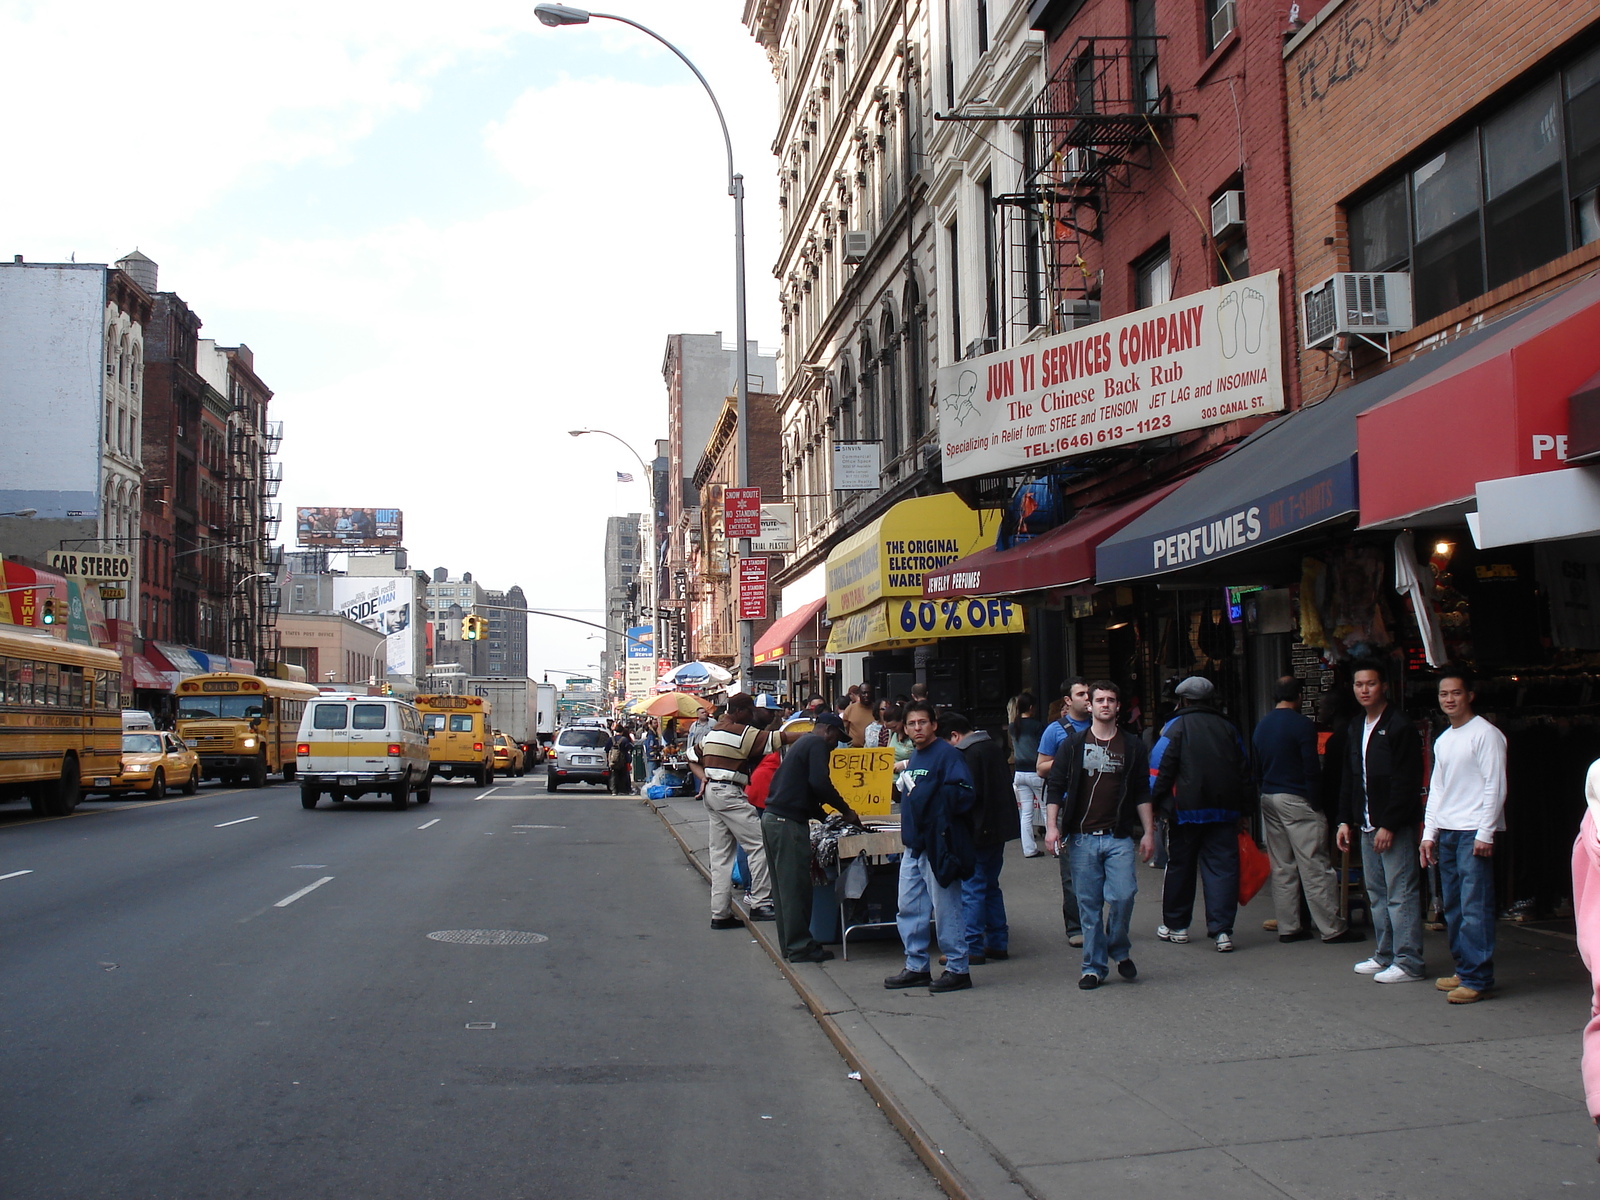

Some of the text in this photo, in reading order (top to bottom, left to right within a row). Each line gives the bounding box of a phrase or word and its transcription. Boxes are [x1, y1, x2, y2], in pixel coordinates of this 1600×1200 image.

[986, 305, 1204, 402] JUN YI SERVICES COMPANY
[1007, 361, 1183, 421] The Chinese Back Rub
[946, 367, 1268, 459] Specializing in Relief form: STREE and TENSION JET LAG and INSOMNIA
[1201, 396, 1265, 420] 303 CANAL ST.
[726, 490, 759, 499] SNOW ROUTE
[375, 509, 399, 523] HUFF
[726, 509, 759, 518] NO STANDING
[769, 541, 789, 550] PLASTIC
[886, 539, 959, 554] THE ORIGINAL
[1153, 506, 1261, 569] PERFUMES
[53, 554, 129, 578] CAR STEREO
[888, 573, 924, 587] WARE
[927, 570, 981, 594] JEWELRY PERFUMES
[102, 588, 121, 597] PIZZA
[340, 591, 396, 621] NSIDE MAN
[967, 600, 1013, 629] OFF
[474, 685, 489, 697] its
[430, 698, 466, 708] SCHOOL BUS
